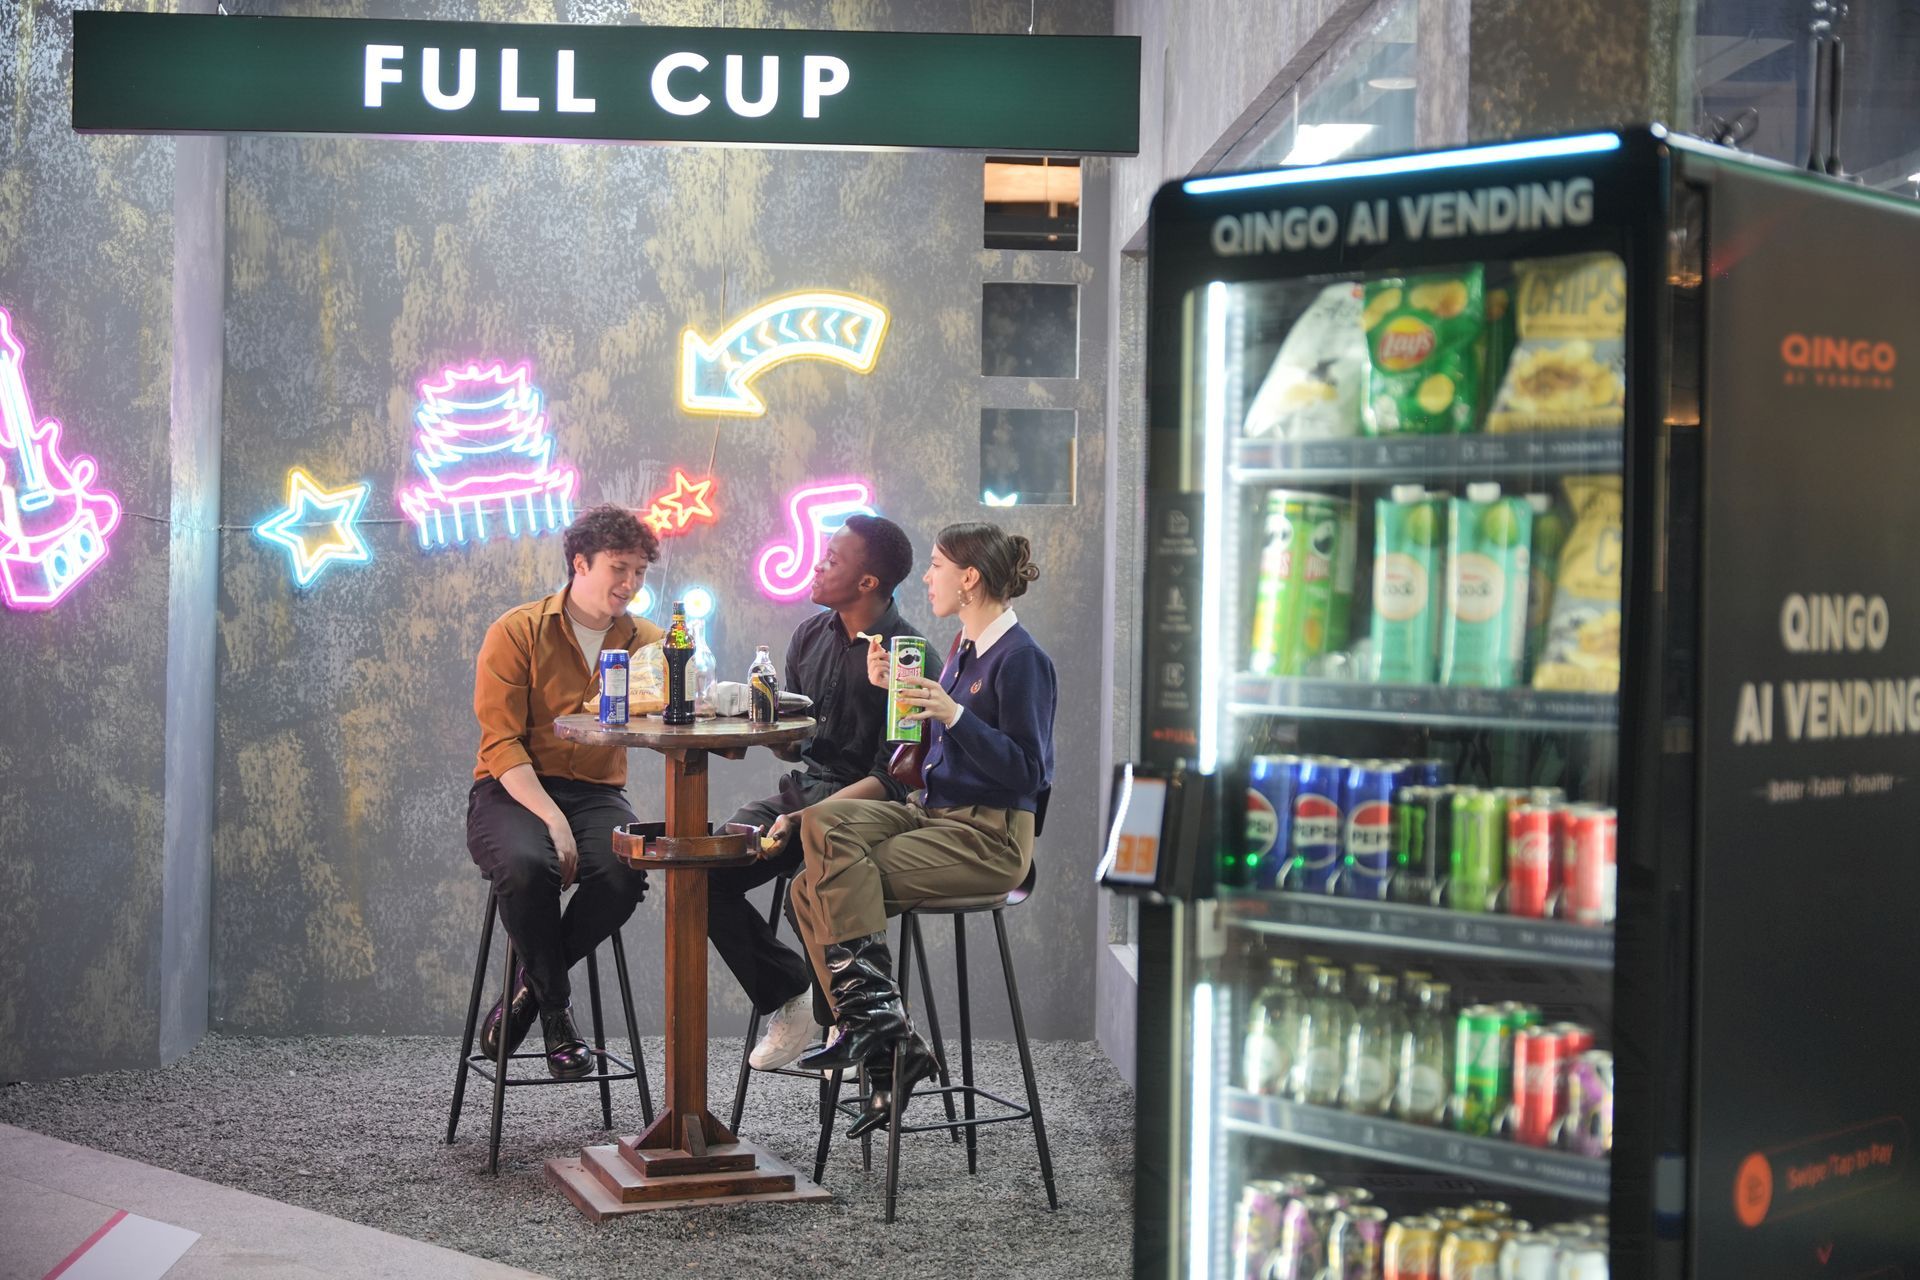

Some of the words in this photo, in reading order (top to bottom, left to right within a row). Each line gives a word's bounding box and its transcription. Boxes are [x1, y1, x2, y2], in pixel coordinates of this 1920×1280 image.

[364, 44, 596, 113] FULL
[650, 51, 851, 119] CUP
[1211, 205, 1338, 256] QINGO
[1346, 199, 1390, 245] AI
[1399, 177, 1595, 241] VENDING
[1780, 332, 1897, 372] QINGO
[1780, 592, 1890, 653] QINGO
[1733, 681, 1775, 746] AI
[1782, 676, 1920, 742] VENDING
